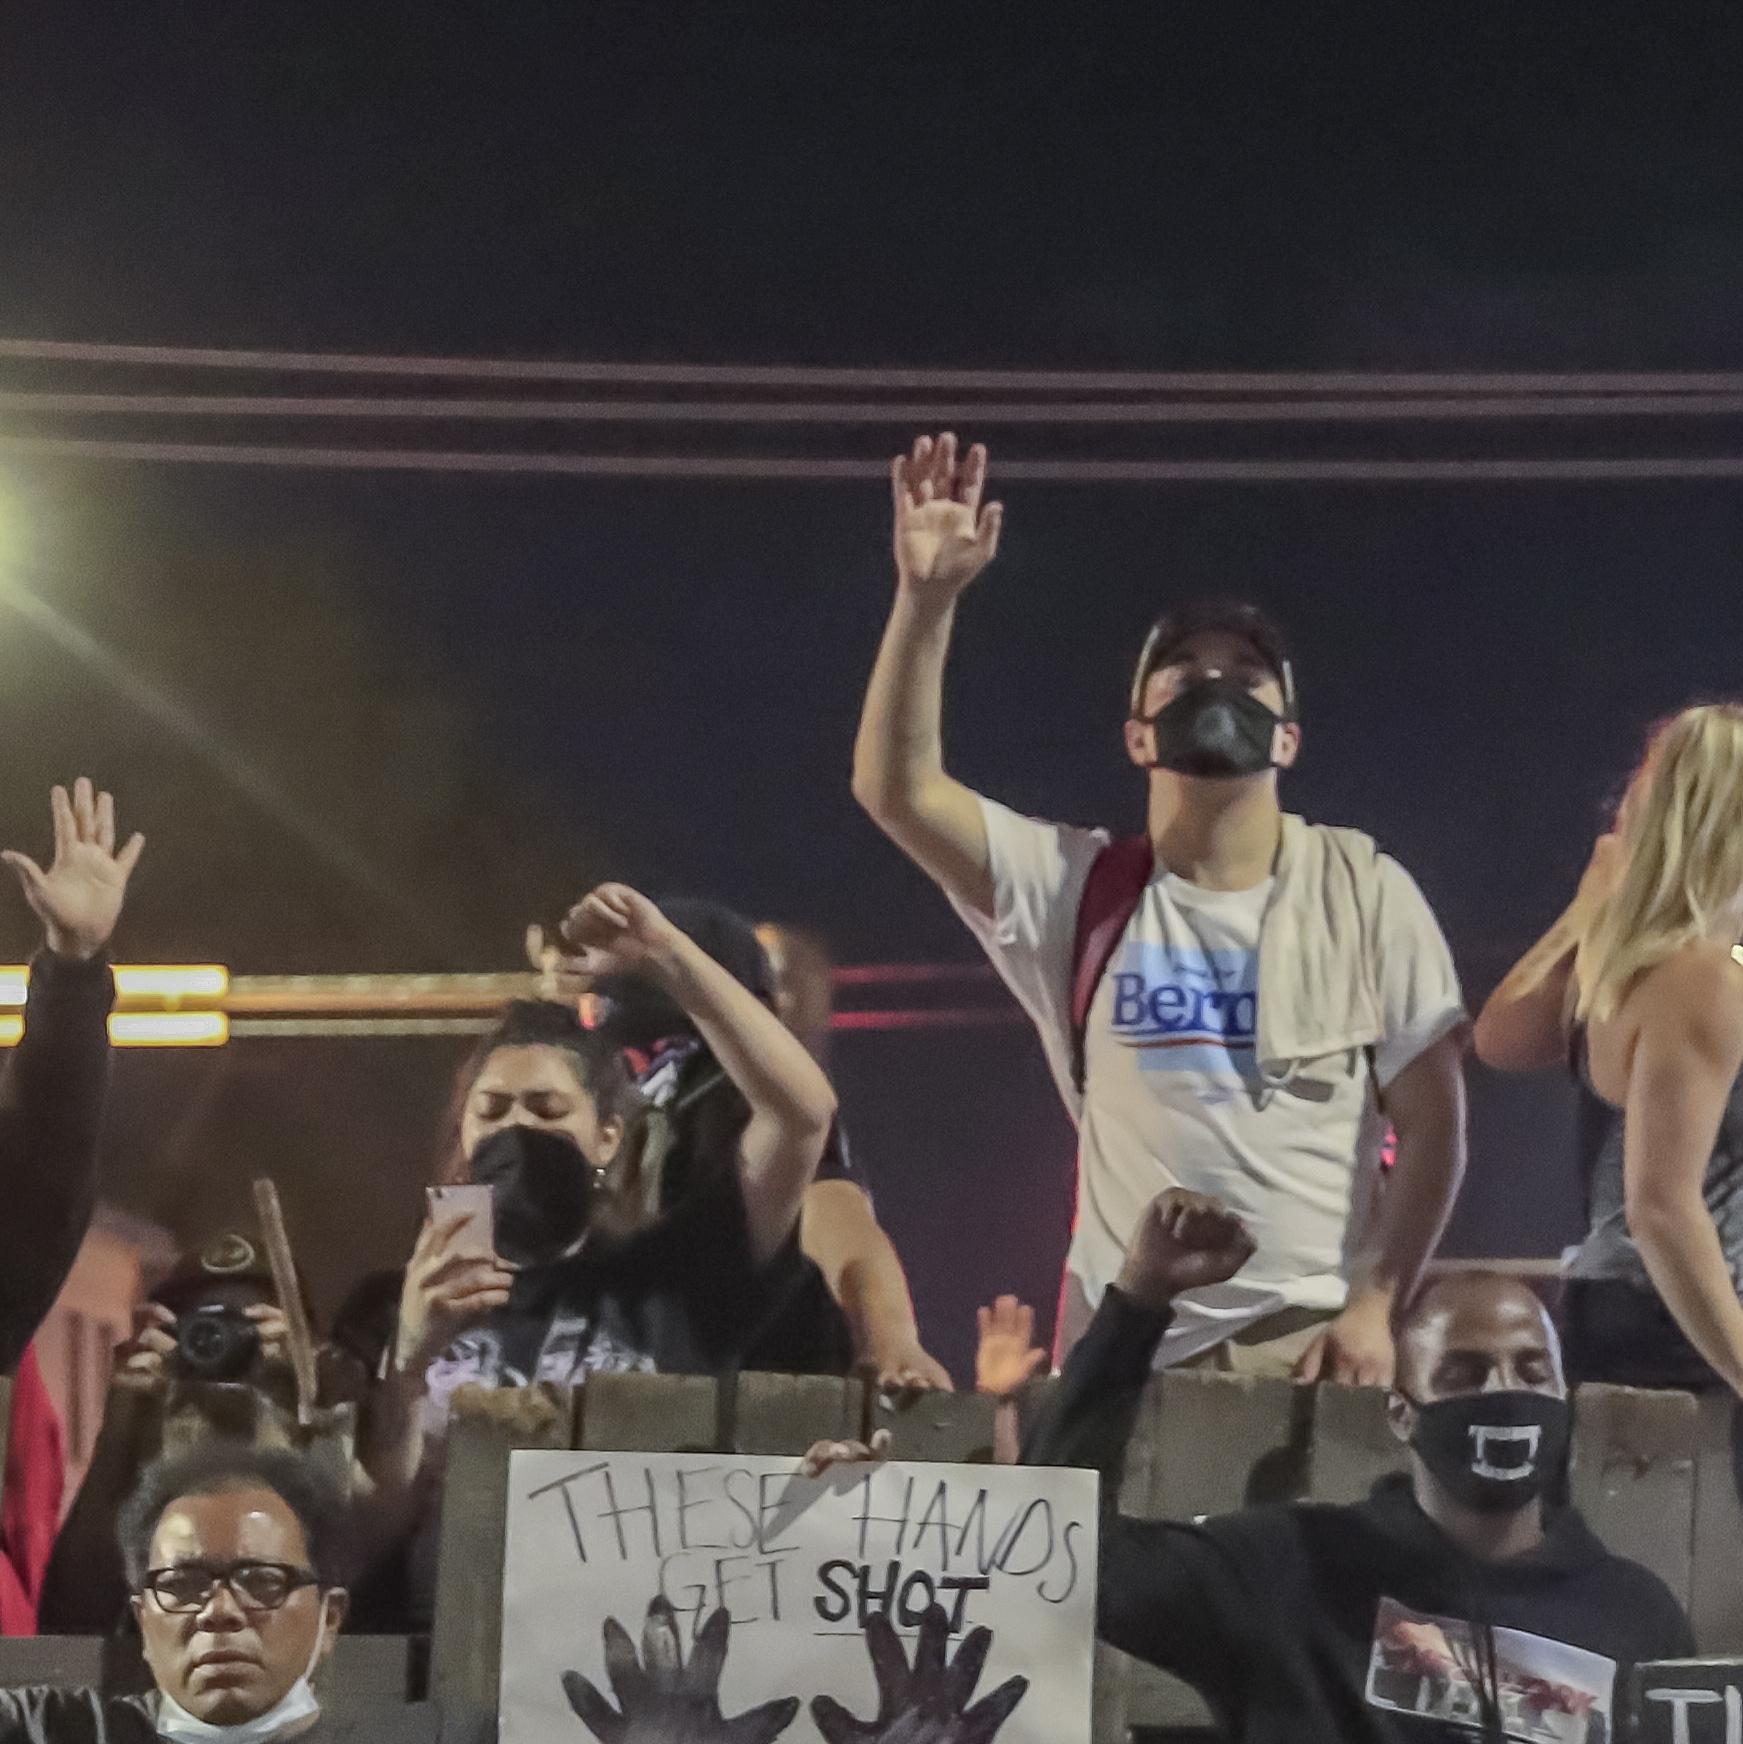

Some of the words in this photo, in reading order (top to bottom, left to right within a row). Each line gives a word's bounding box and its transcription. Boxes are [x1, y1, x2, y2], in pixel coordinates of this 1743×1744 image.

[529, 1461, 805, 1562] THESE
[852, 1473, 1083, 1603] HANDS
[658, 1551, 786, 1625] GET
[814, 1559, 991, 1634] SHOT
